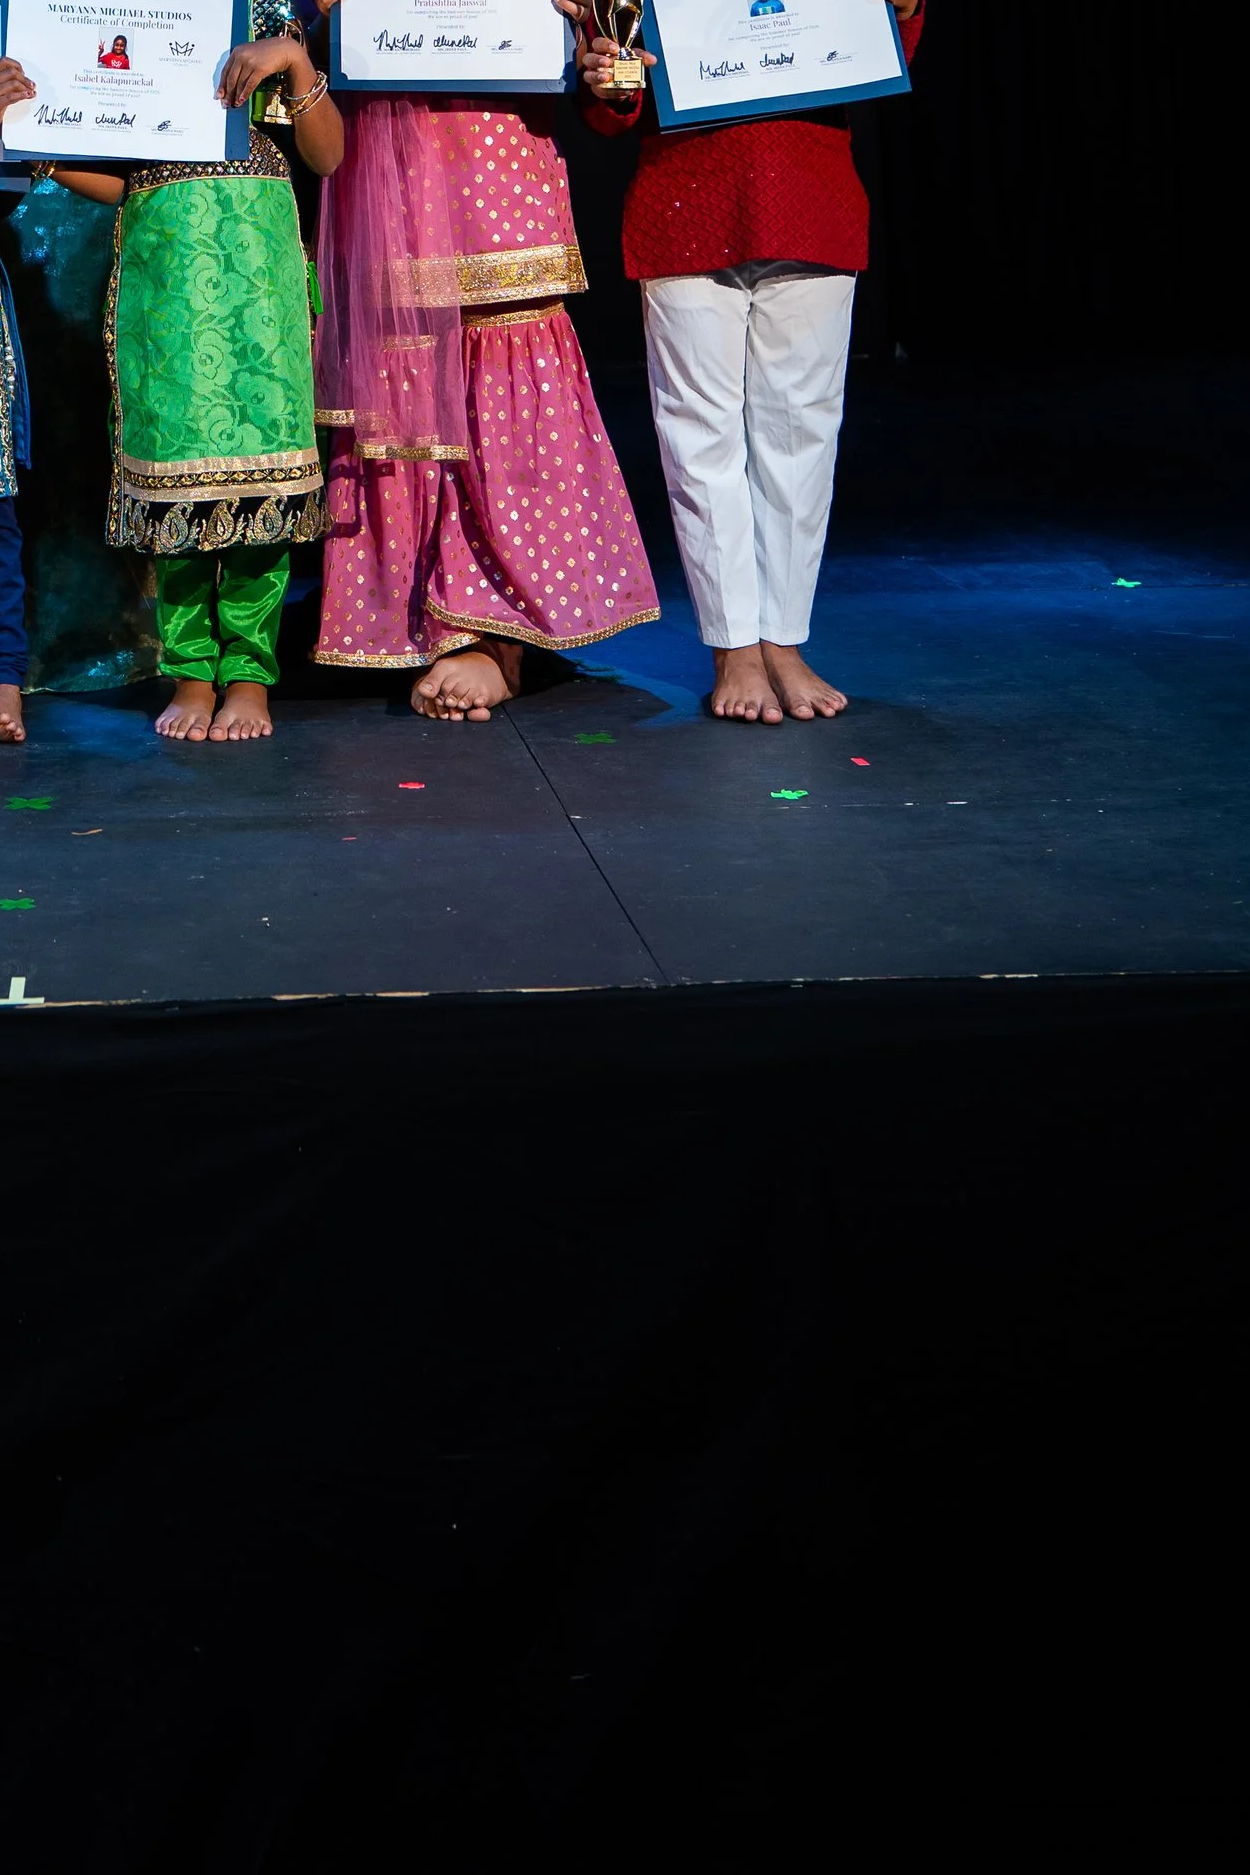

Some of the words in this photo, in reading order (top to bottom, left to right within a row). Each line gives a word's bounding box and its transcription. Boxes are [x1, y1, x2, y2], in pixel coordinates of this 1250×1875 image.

[415, 0, 456, 7] Pratishtha
[459, 0, 487, 8] Jaiswal
[48, 4, 96, 14] MARYANN
[100, 7, 145, 18] MICHAEL
[148, 11, 192, 21] STUDIOS
[61, 15, 108, 25] Certificate
[110, 18, 120, 26] of
[122, 19, 174, 30] Completion
[750, 23, 771, 31] Isaac
[773, 18, 791, 27] Paul
[75, 74, 98, 82] Isabel
